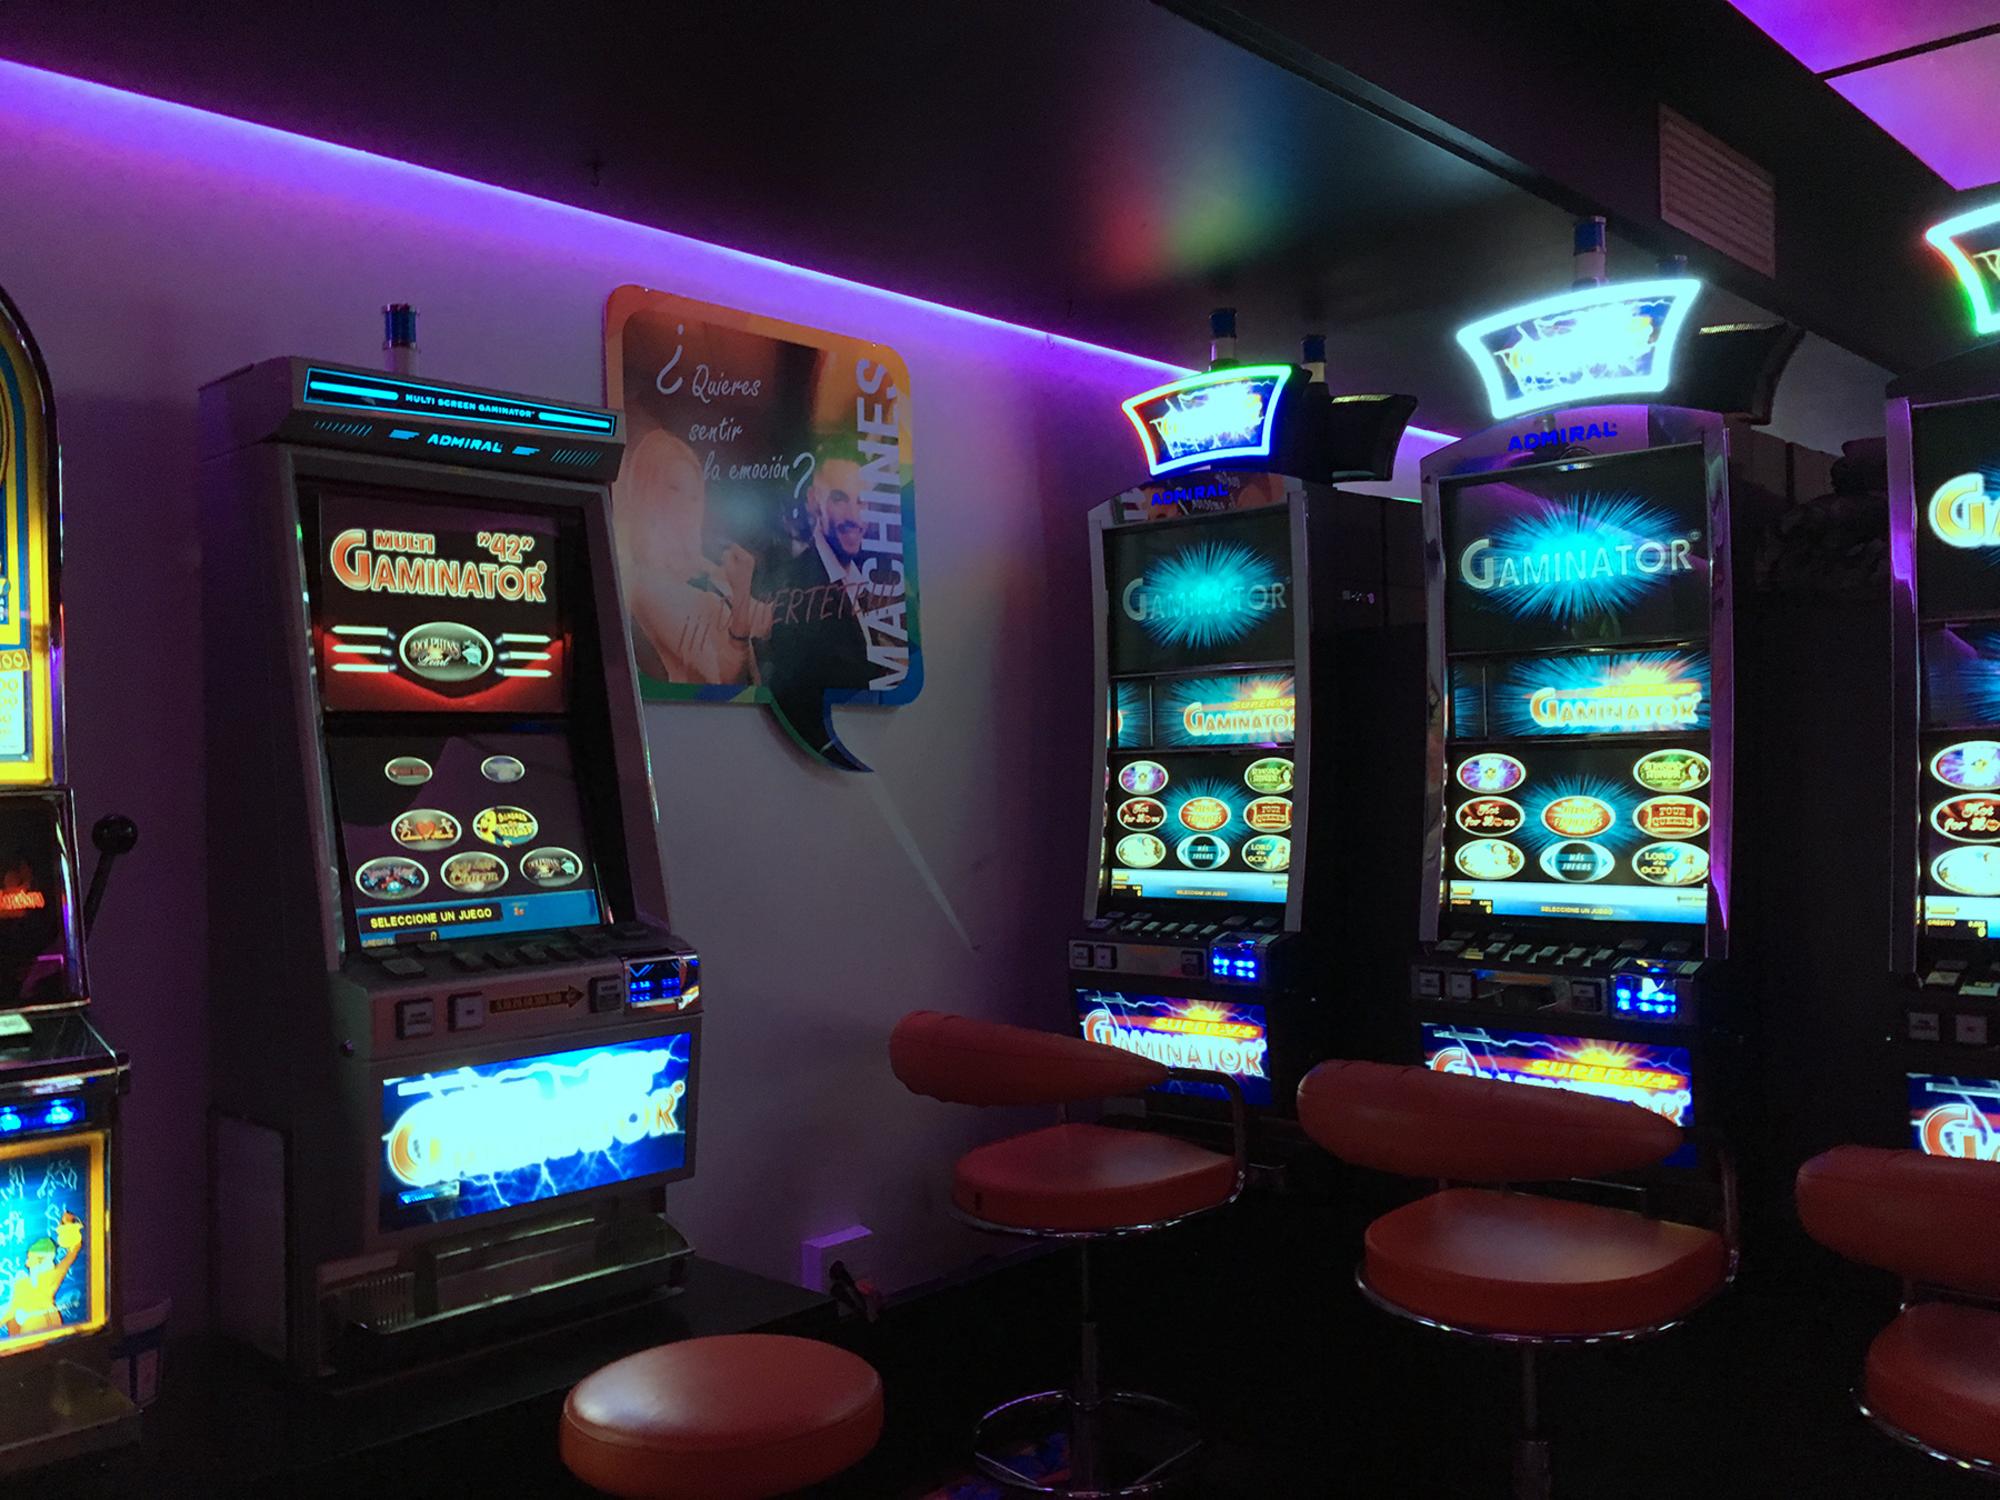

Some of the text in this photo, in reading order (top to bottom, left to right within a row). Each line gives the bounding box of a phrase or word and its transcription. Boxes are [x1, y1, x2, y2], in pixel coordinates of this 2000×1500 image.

[405, 394, 435, 405] MULTI
[438, 398, 476, 411] SCREEN
[427, 432, 503, 453] ADMIRAL
[689, 418, 743, 443] sentir
[1507, 421, 1618, 451] ADMIRAL
[704, 451, 721, 481] la
[1151, 482, 1230, 506] ADMIRAL
[855, 358, 910, 691] MACHINES
[373, 530, 436, 554] MULTI
[330, 528, 547, 603] GAMINATOR
[1459, 537, 1693, 590] GAMINATOR
[1529, 686, 1703, 728] GAMINATOR
[370, 907, 493, 929] SELECCIONE UN JUEGO
